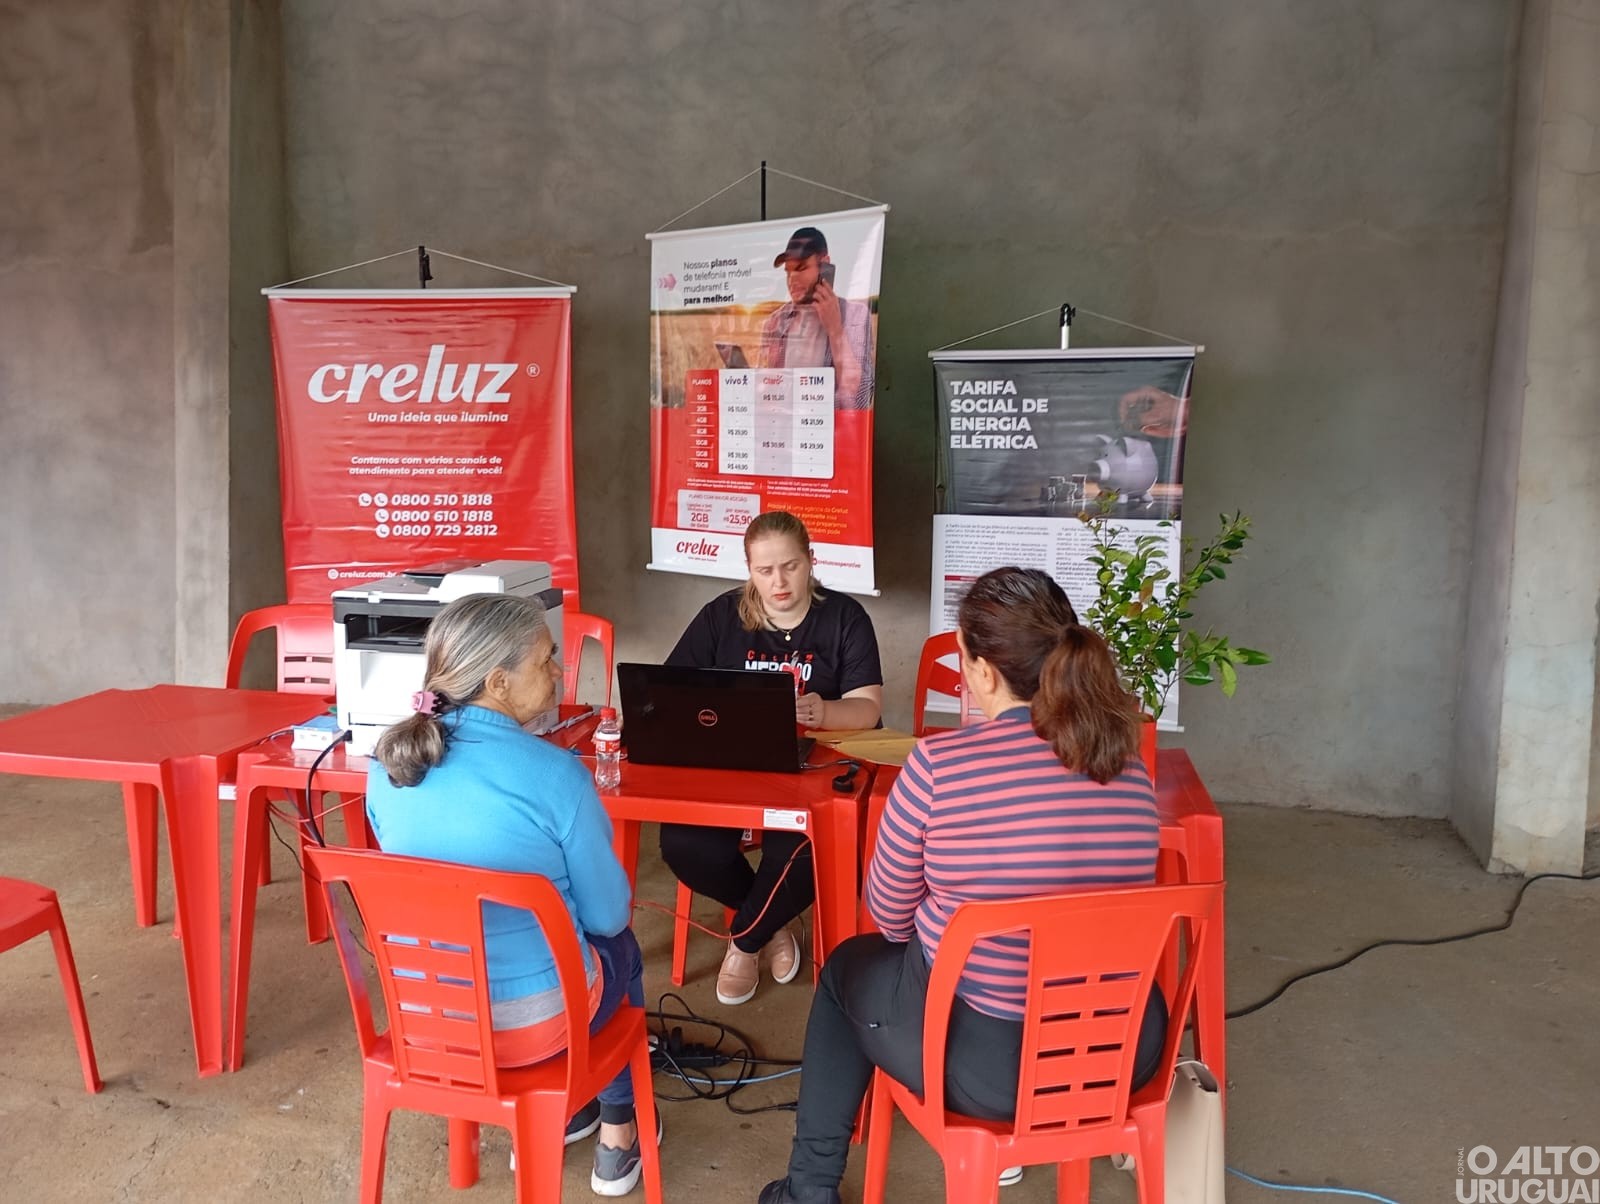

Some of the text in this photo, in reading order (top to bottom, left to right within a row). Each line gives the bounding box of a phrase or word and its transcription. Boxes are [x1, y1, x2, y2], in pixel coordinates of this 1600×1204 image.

[683, 258, 738, 270] Nossos planos
[683, 268, 752, 282] de telefonia móvel
[683, 282, 729, 293] mudaram! E
[683, 294, 734, 306] para melhor!
[307, 344, 519, 404] creluz
[724, 376, 742, 385] vivo
[808, 376, 825, 385] TIM
[950, 380, 1017, 395] TARIFA
[950, 398, 1049, 413] SOCIAL DE
[368, 411, 509, 425] Uma ideia que ilumina
[950, 416, 1031, 431] ENERGIA
[950, 431, 1039, 449] ELÉTRICA
[351, 456, 502, 465] Contamos com vários canais de
[349, 466, 502, 477] atendimento para atender você!
[391, 494, 493, 506] 0800 510 1818
[391, 510, 493, 522] 0800 610 1818
[691, 512, 709, 523] 2GB
[729, 514, 753, 526] 25,90
[392, 524, 498, 536] 0800 729 2812
[676, 538, 720, 557] creluz
